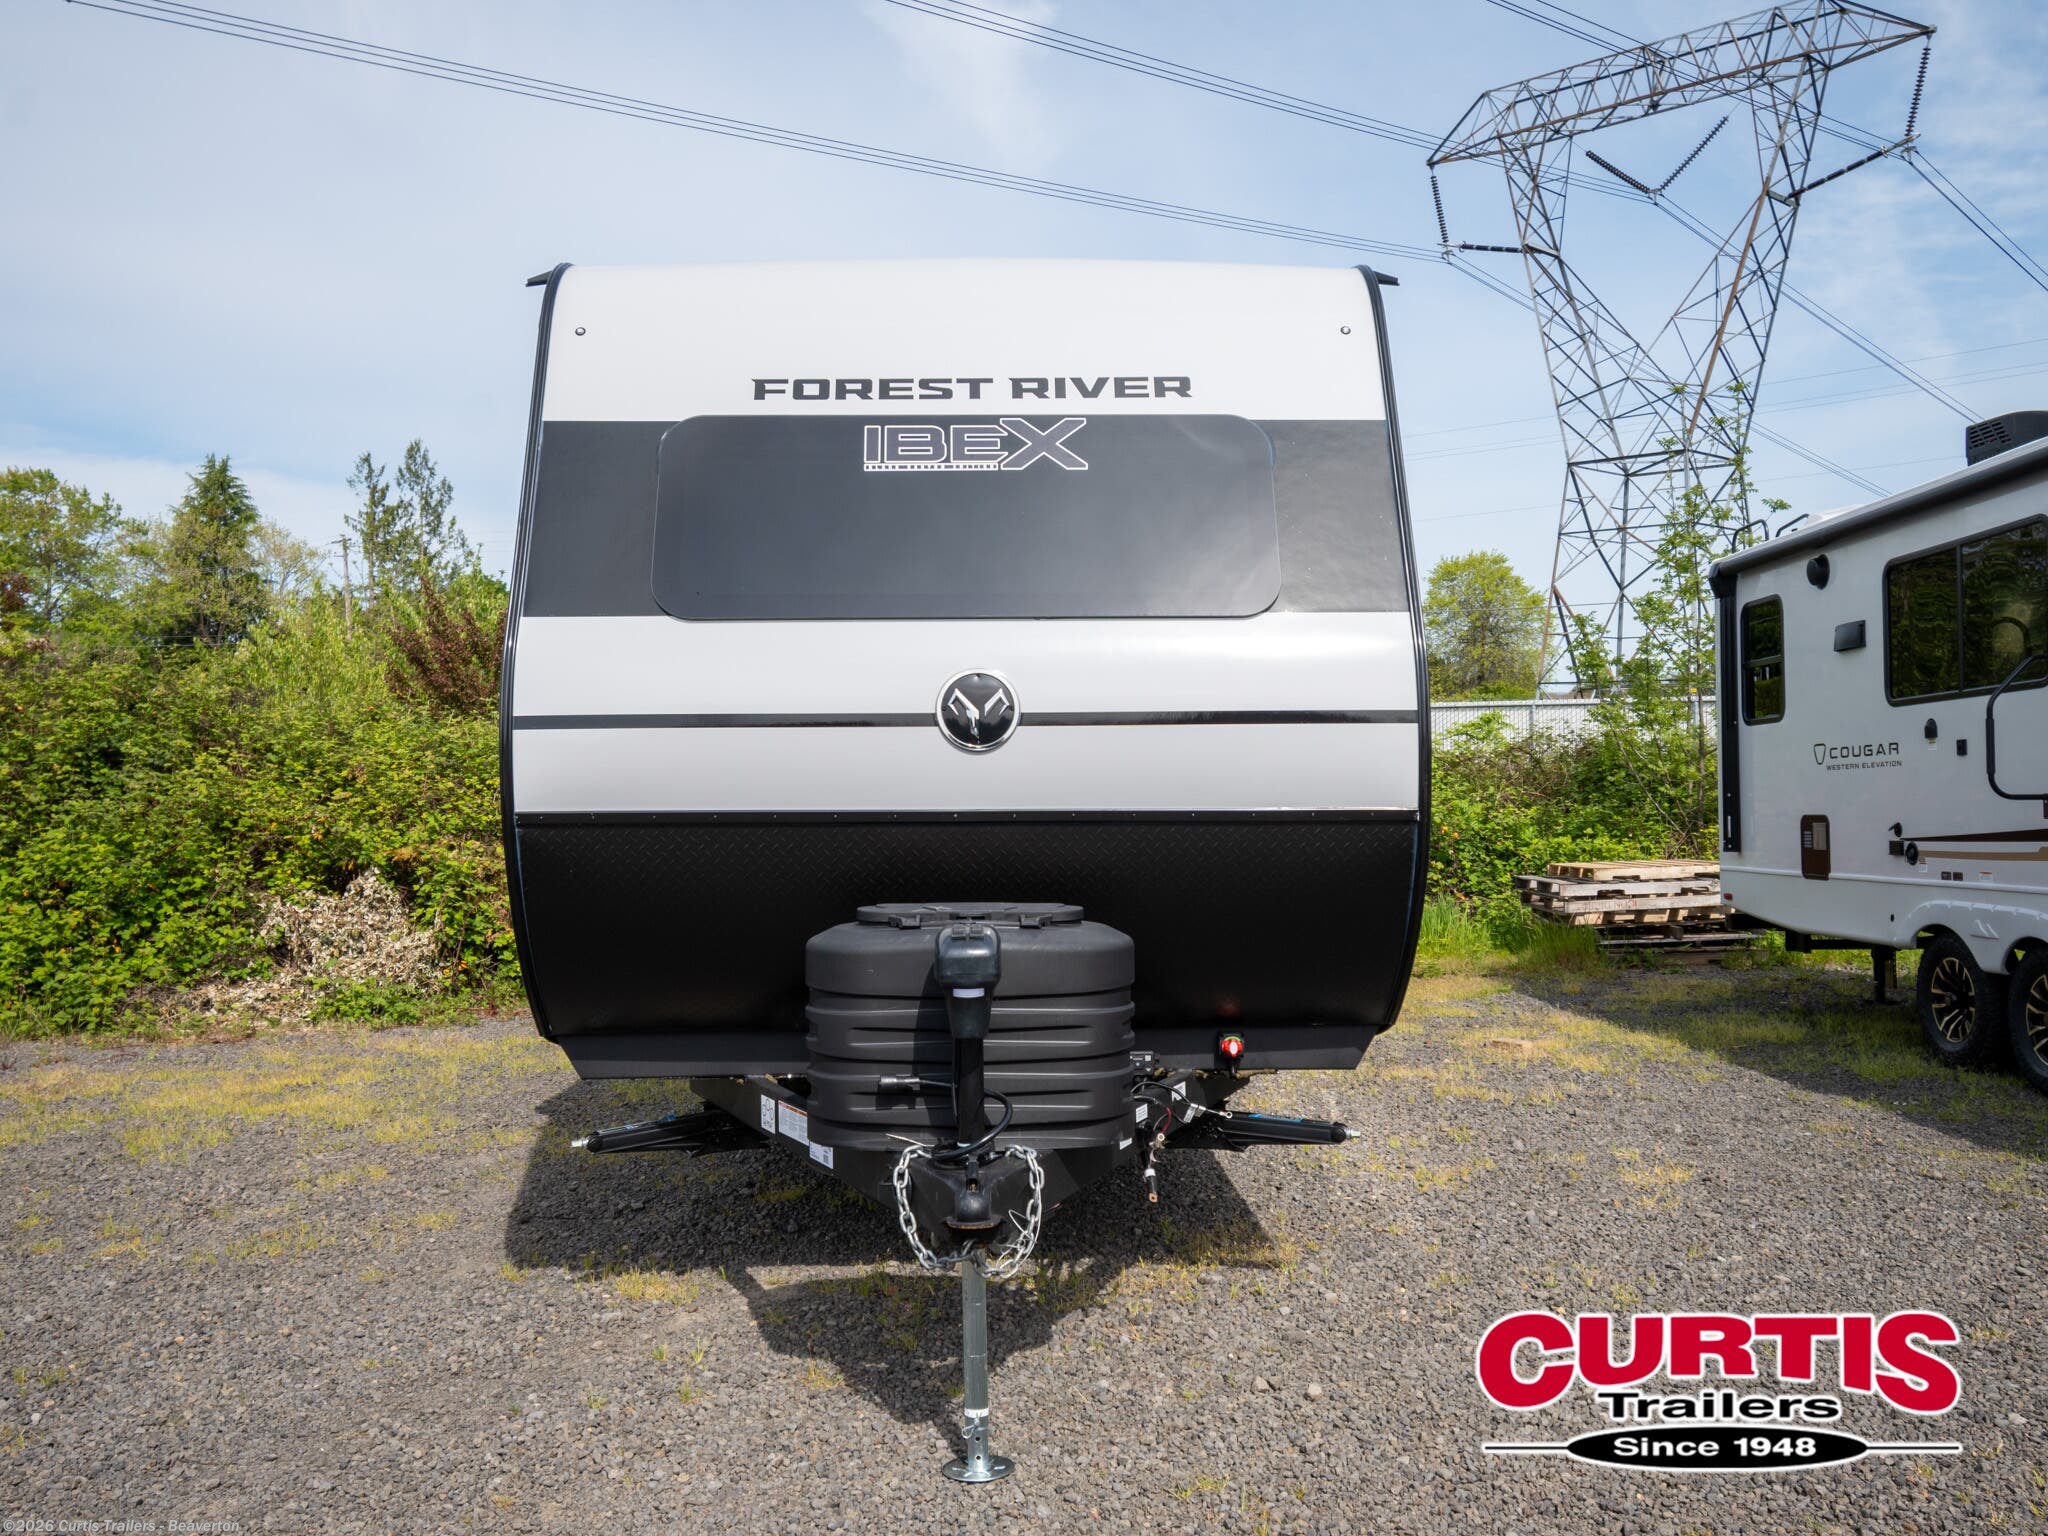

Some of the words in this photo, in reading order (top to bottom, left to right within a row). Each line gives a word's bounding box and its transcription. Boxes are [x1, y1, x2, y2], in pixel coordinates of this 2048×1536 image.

[751, 377, 994, 400] FOREST
[1008, 376, 1192, 399] RIVER
[863, 417, 1088, 470] IBEX
[1829, 742, 1899, 759] COUGAR
[1826, 763, 1860, 771] WESTERN
[1861, 760, 1902, 769] ELEVATION
